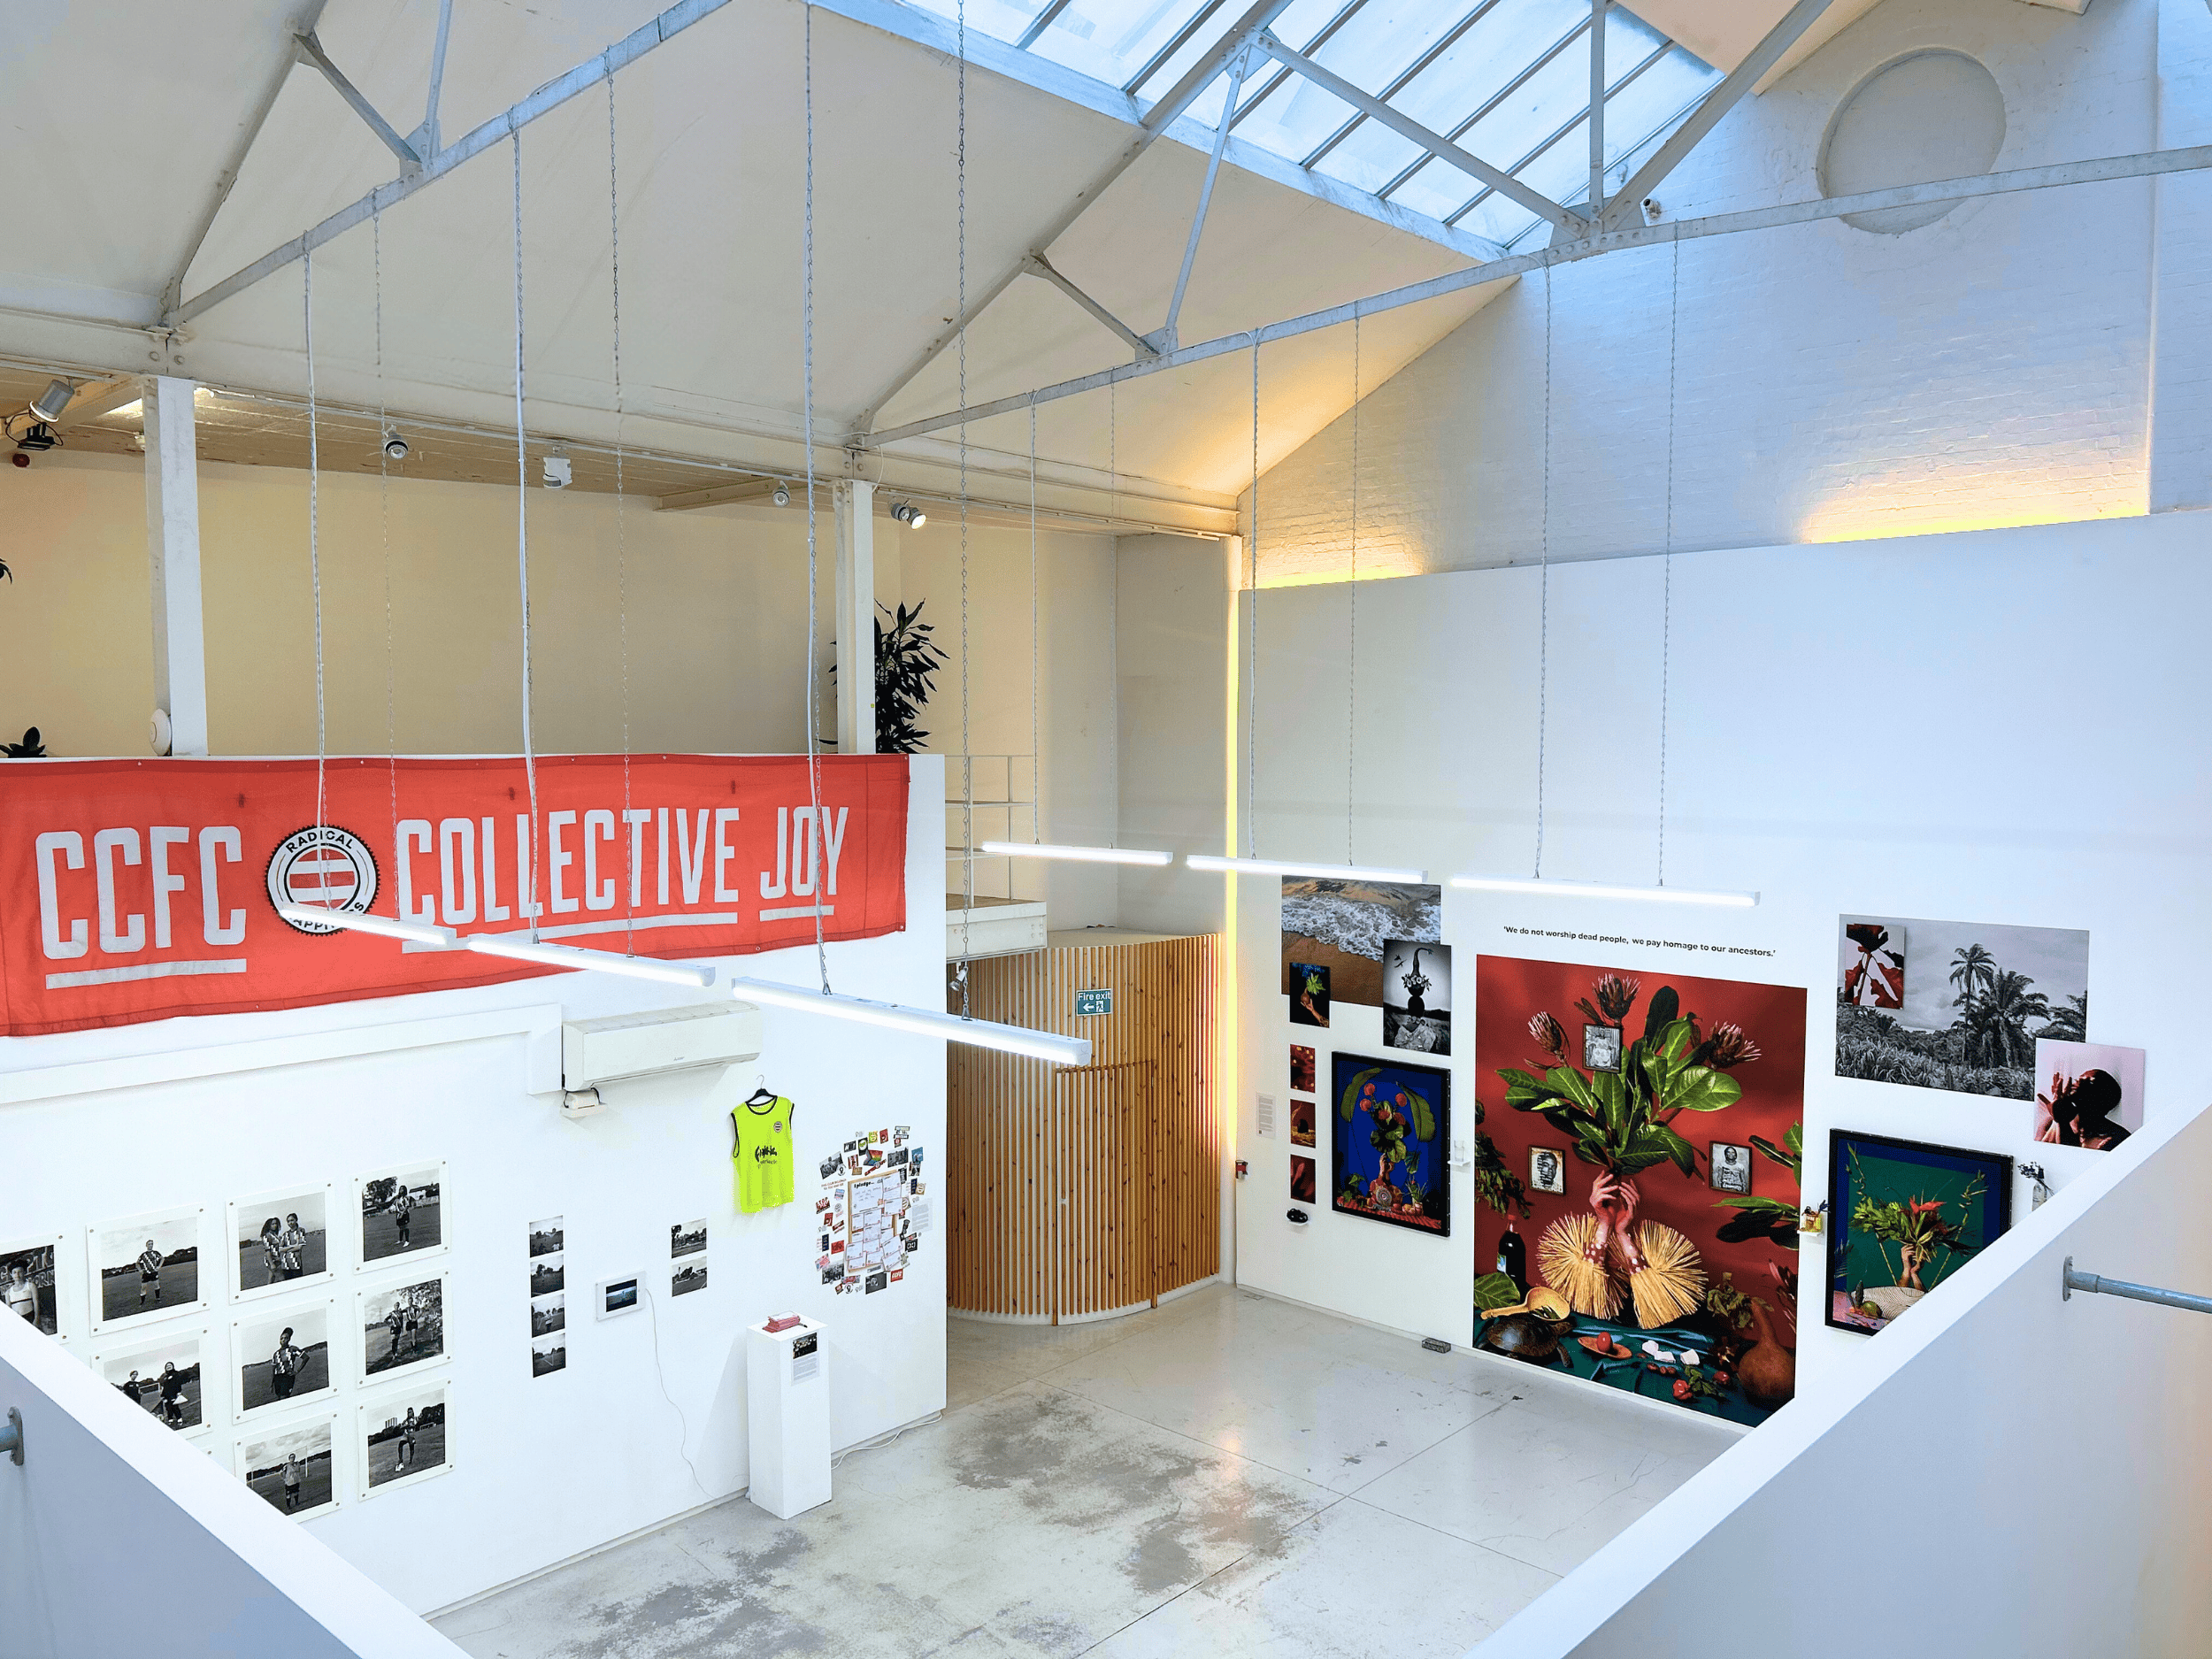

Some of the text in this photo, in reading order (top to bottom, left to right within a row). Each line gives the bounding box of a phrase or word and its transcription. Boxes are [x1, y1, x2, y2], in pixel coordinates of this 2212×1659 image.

[285, 830, 356, 854] RADICAL
[35, 806, 849, 960] CCFC COLLECTIVE JOY
[1546, 931, 1577, 940] worship
[1600, 935, 1629, 945] people,
[1647, 940, 1662, 949] pay
[1663, 940, 1699, 951] homage
[1078, 991, 1111, 1001] Fire exit
